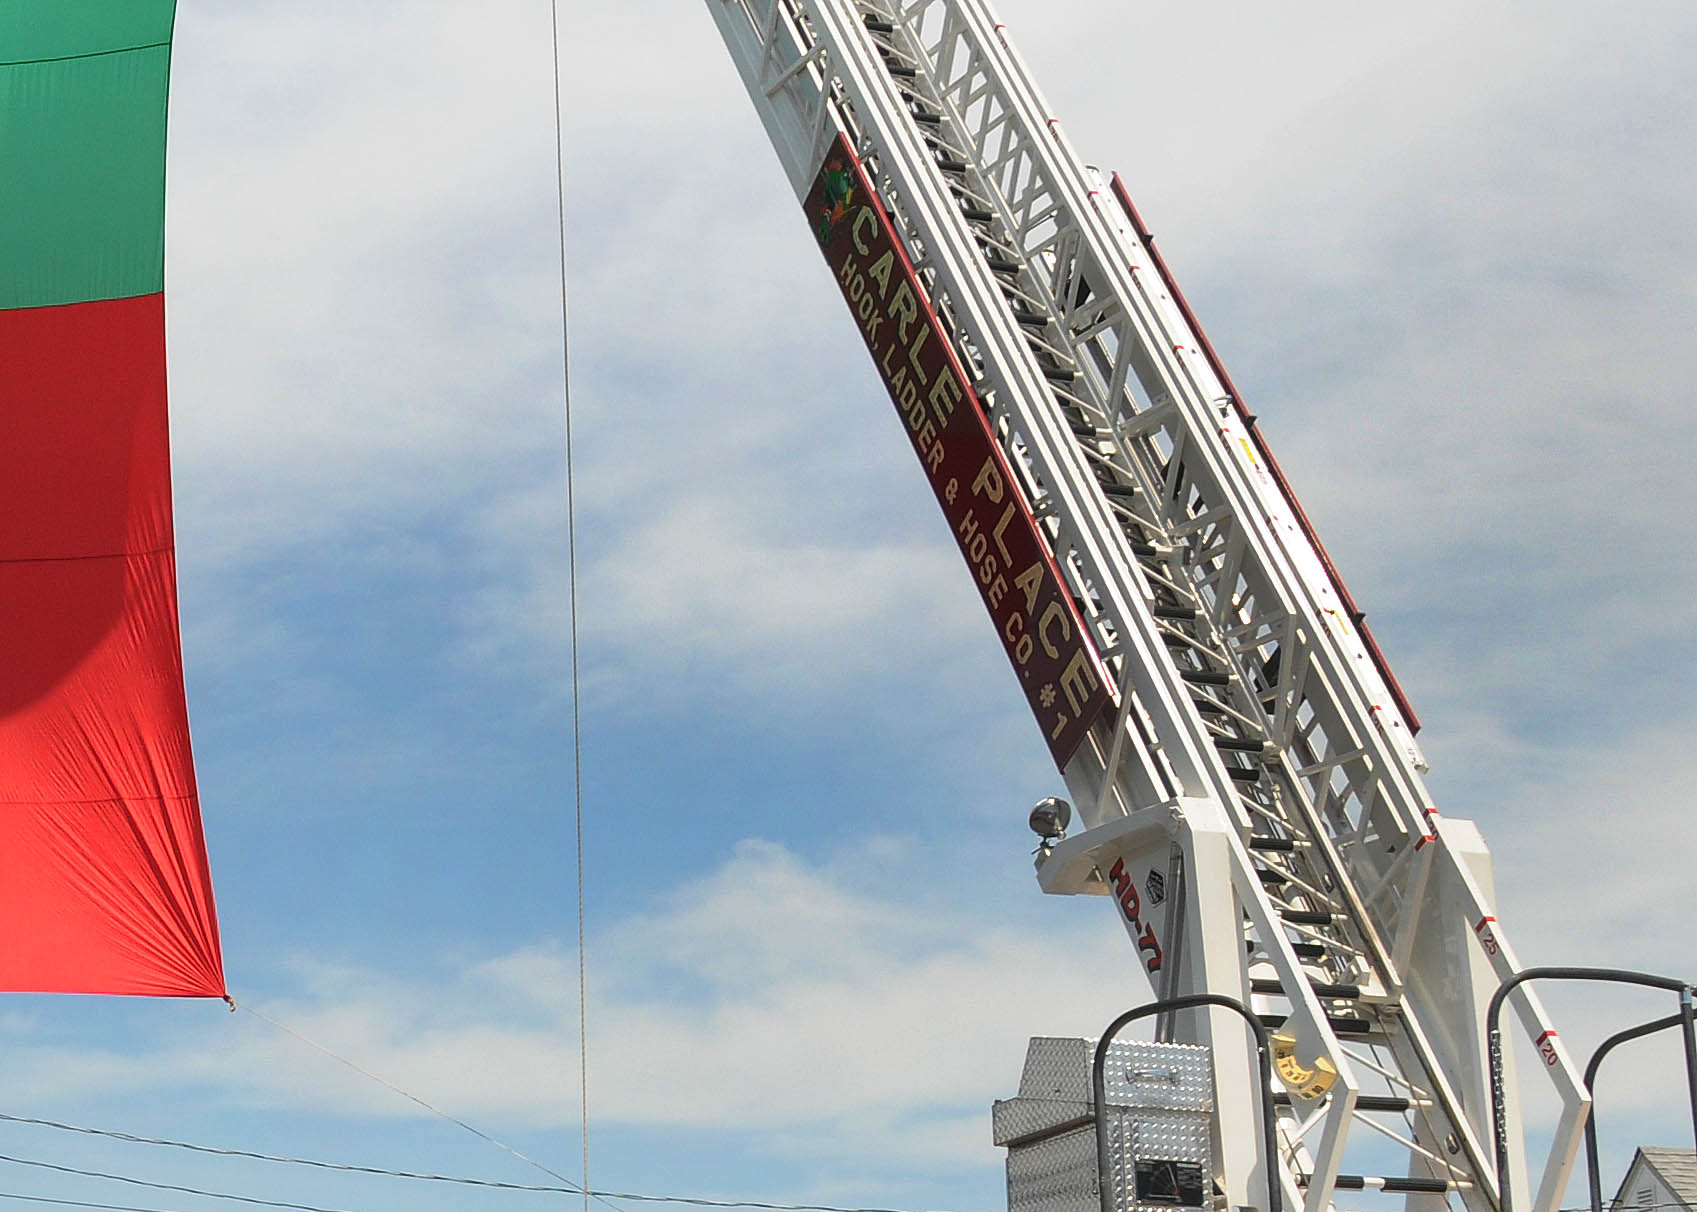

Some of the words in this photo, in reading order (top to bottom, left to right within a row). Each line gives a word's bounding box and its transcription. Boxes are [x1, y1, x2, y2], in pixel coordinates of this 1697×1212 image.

[840, 254, 884, 350] HOOK,
[882, 344, 945, 474] LADDER
[945, 478, 958, 505] &
[959, 509, 1008, 610] HOSE
[1006, 612, 1033, 678] CO.
[852, 205, 963, 429] CARLE
[971, 456, 1098, 718] PLACE
[1109, 856, 1163, 974] HD-77
[1483, 932, 1499, 956] 25
[1542, 1042, 1558, 1066] 20
